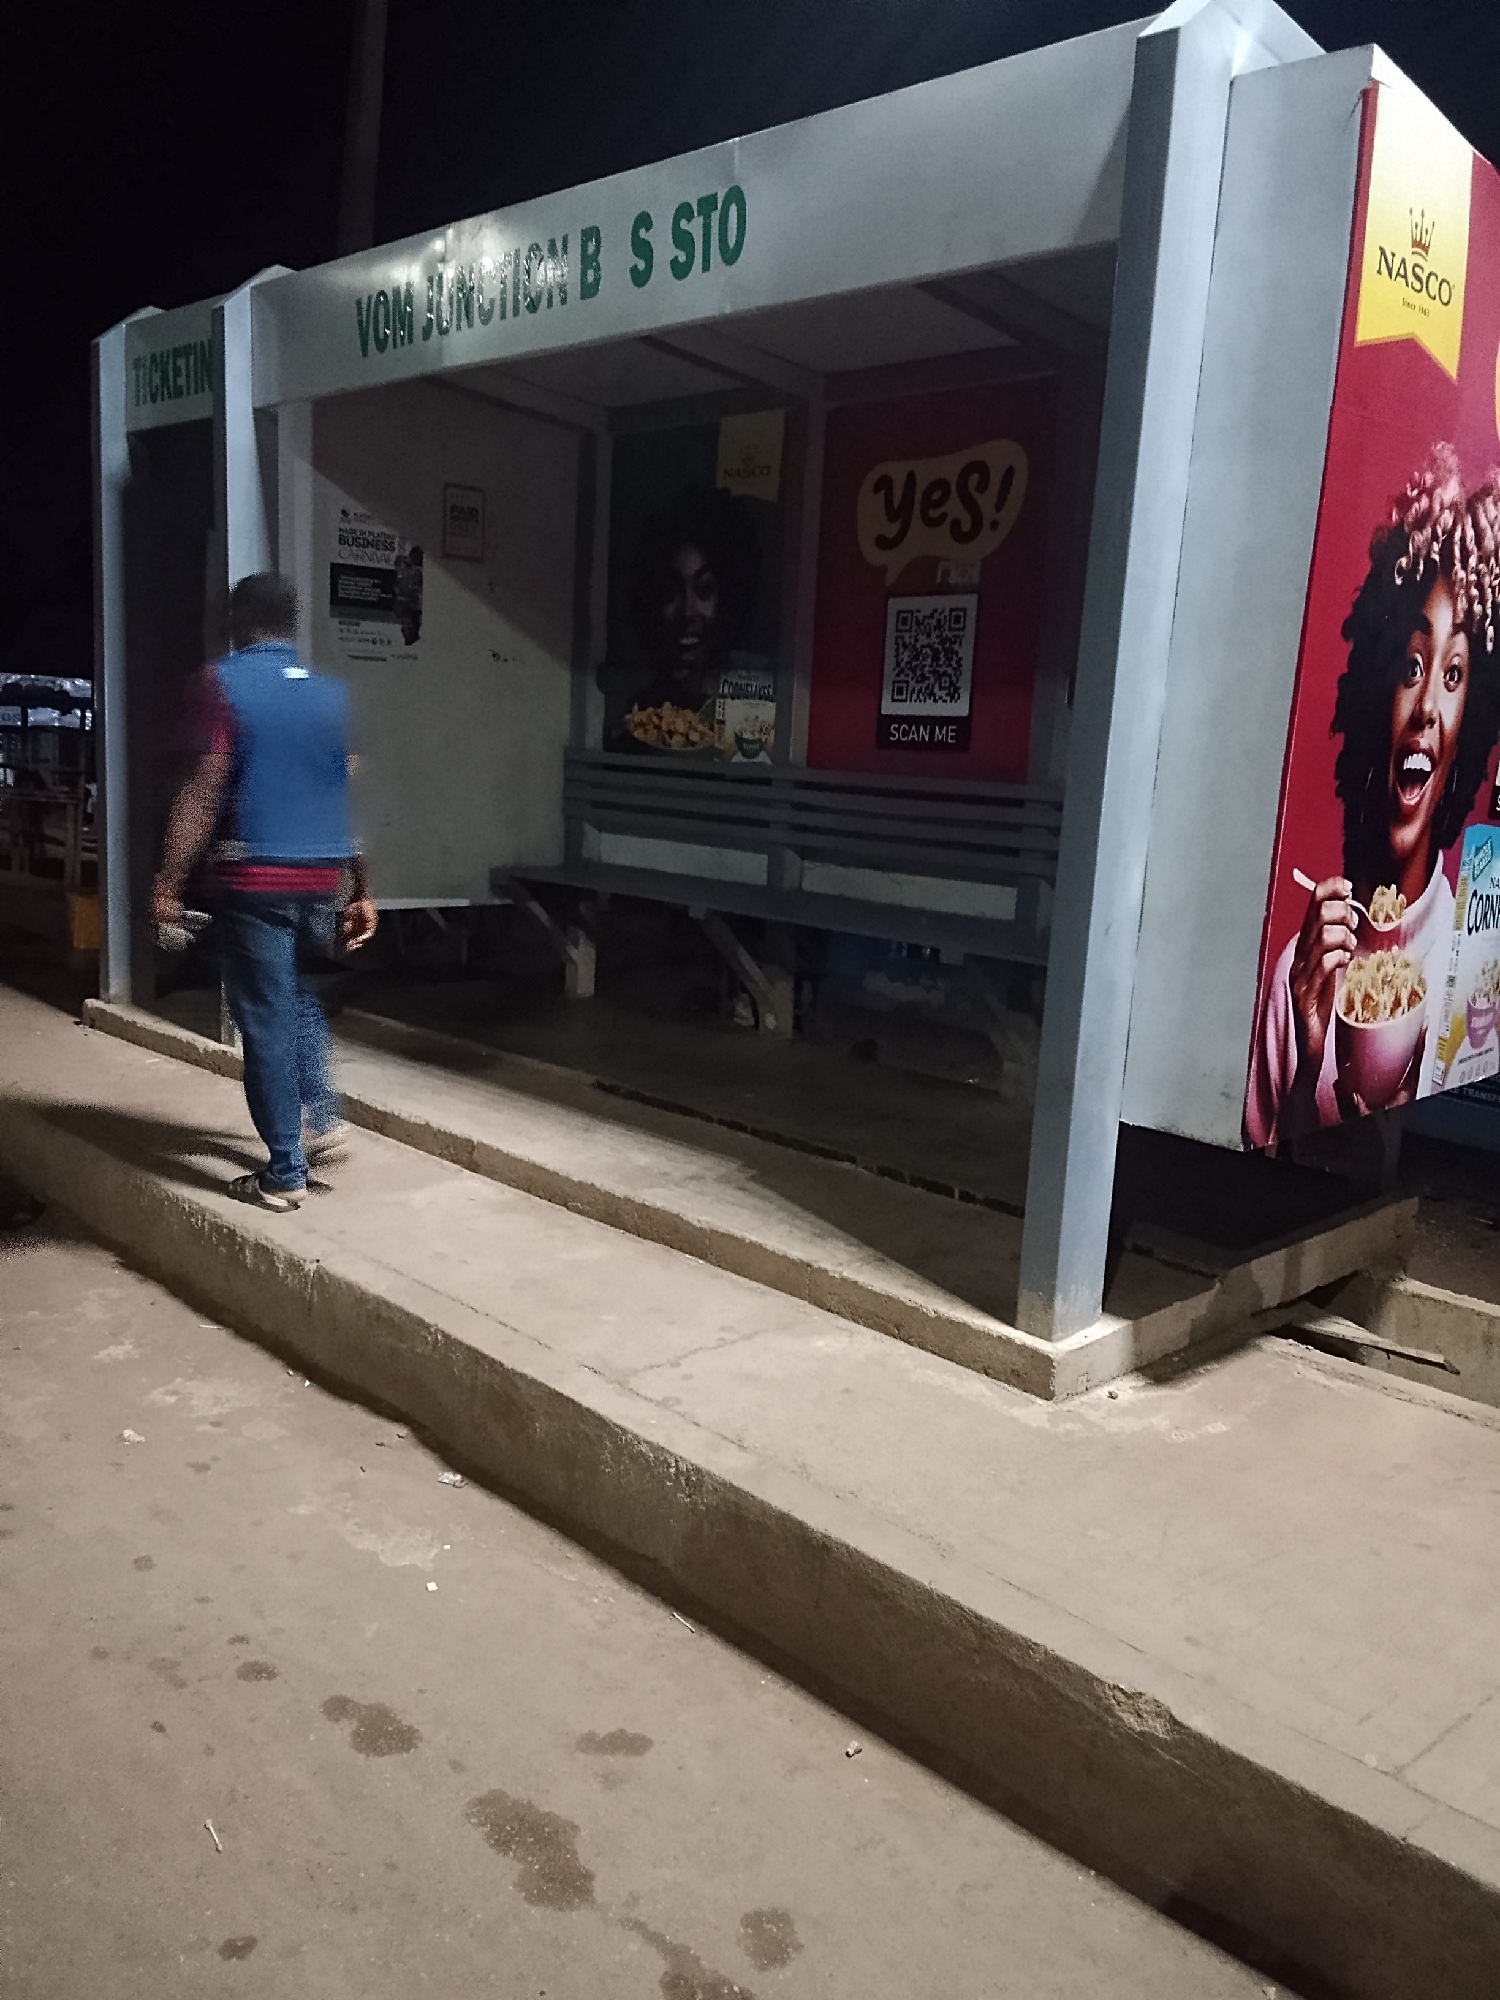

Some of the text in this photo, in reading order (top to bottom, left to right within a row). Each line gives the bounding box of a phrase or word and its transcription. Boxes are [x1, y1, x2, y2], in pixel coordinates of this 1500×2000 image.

[355, 281, 414, 358] VOM
[422, 233, 569, 342] JUNCTION
[670, 185, 747, 281] STO
[1376, 245, 1453, 307] NASCO
[338, 533, 396, 552] BUSINESS
[889, 723, 957, 743] SCAN ME
